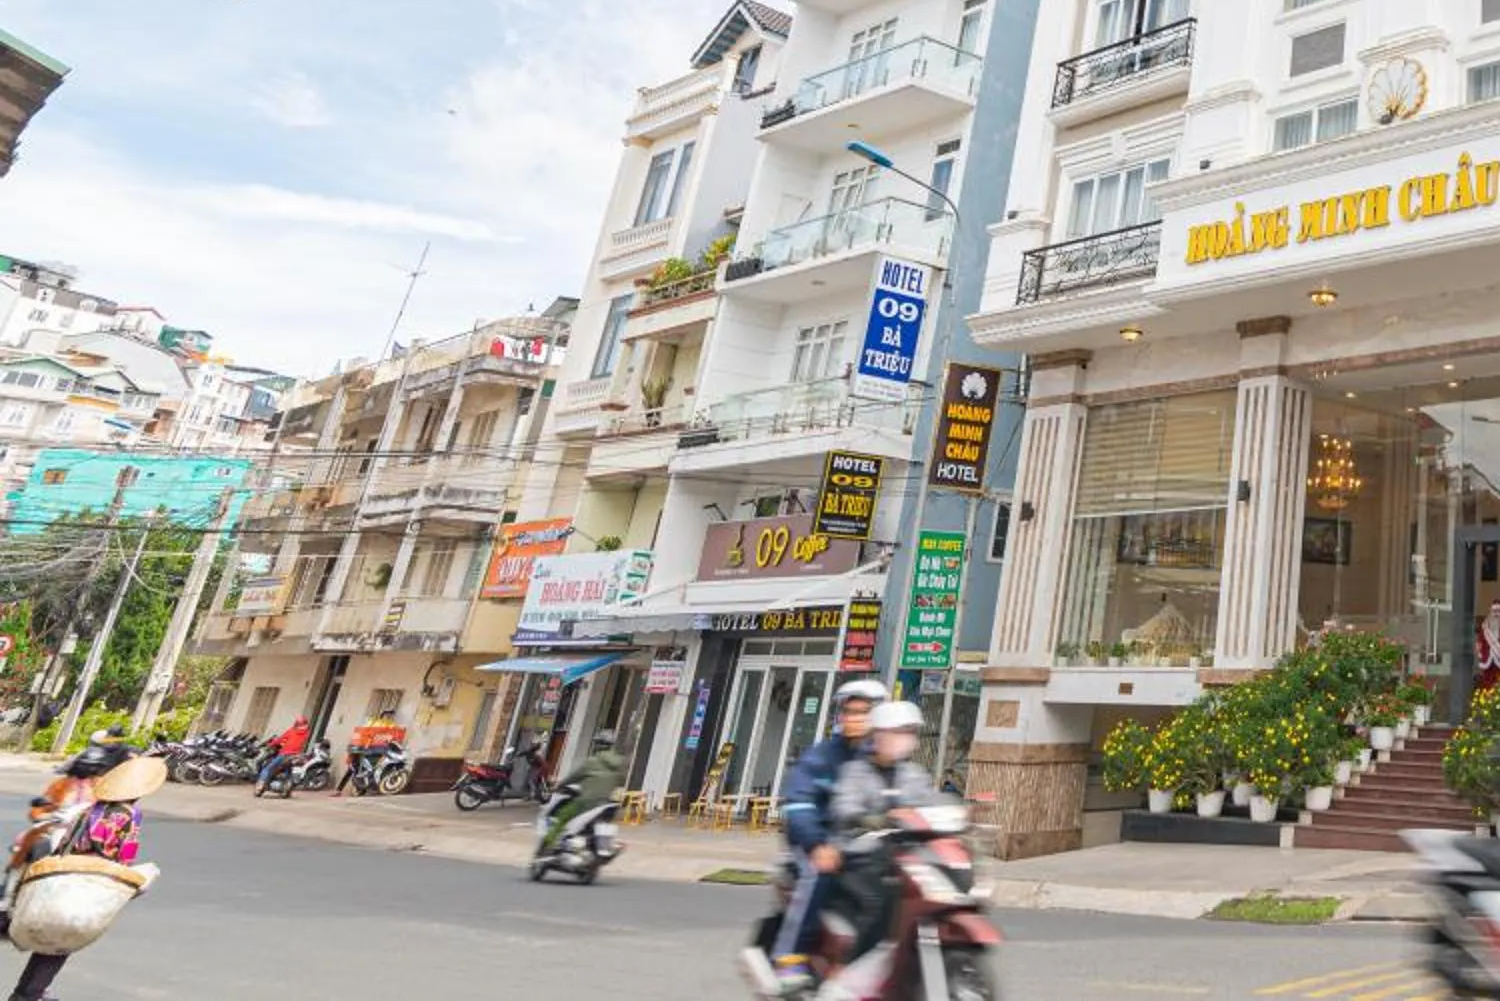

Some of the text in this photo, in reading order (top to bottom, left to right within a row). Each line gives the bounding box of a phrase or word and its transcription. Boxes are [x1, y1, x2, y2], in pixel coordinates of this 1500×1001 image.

[1184, 201, 1291, 266] HOÀNG
[1297, 184, 1391, 244] MINH
[881, 260, 924, 294] HOTEL
[878, 297, 919, 322] 09
[881, 323, 902, 347] BÀ
[865, 348, 911, 376] TRIỆU
[947, 401, 992, 424] HOÀNG
[948, 422, 984, 442] MINH
[945, 440, 980, 462] CHÂU
[833, 456, 876, 474] HOTEL
[937, 462, 979, 483] HOTEL
[831, 474, 873, 489] 09
[755, 523, 829, 568] 09 Coffee
[762, 612, 782, 631] 09
[810, 608, 843, 630] TRI
